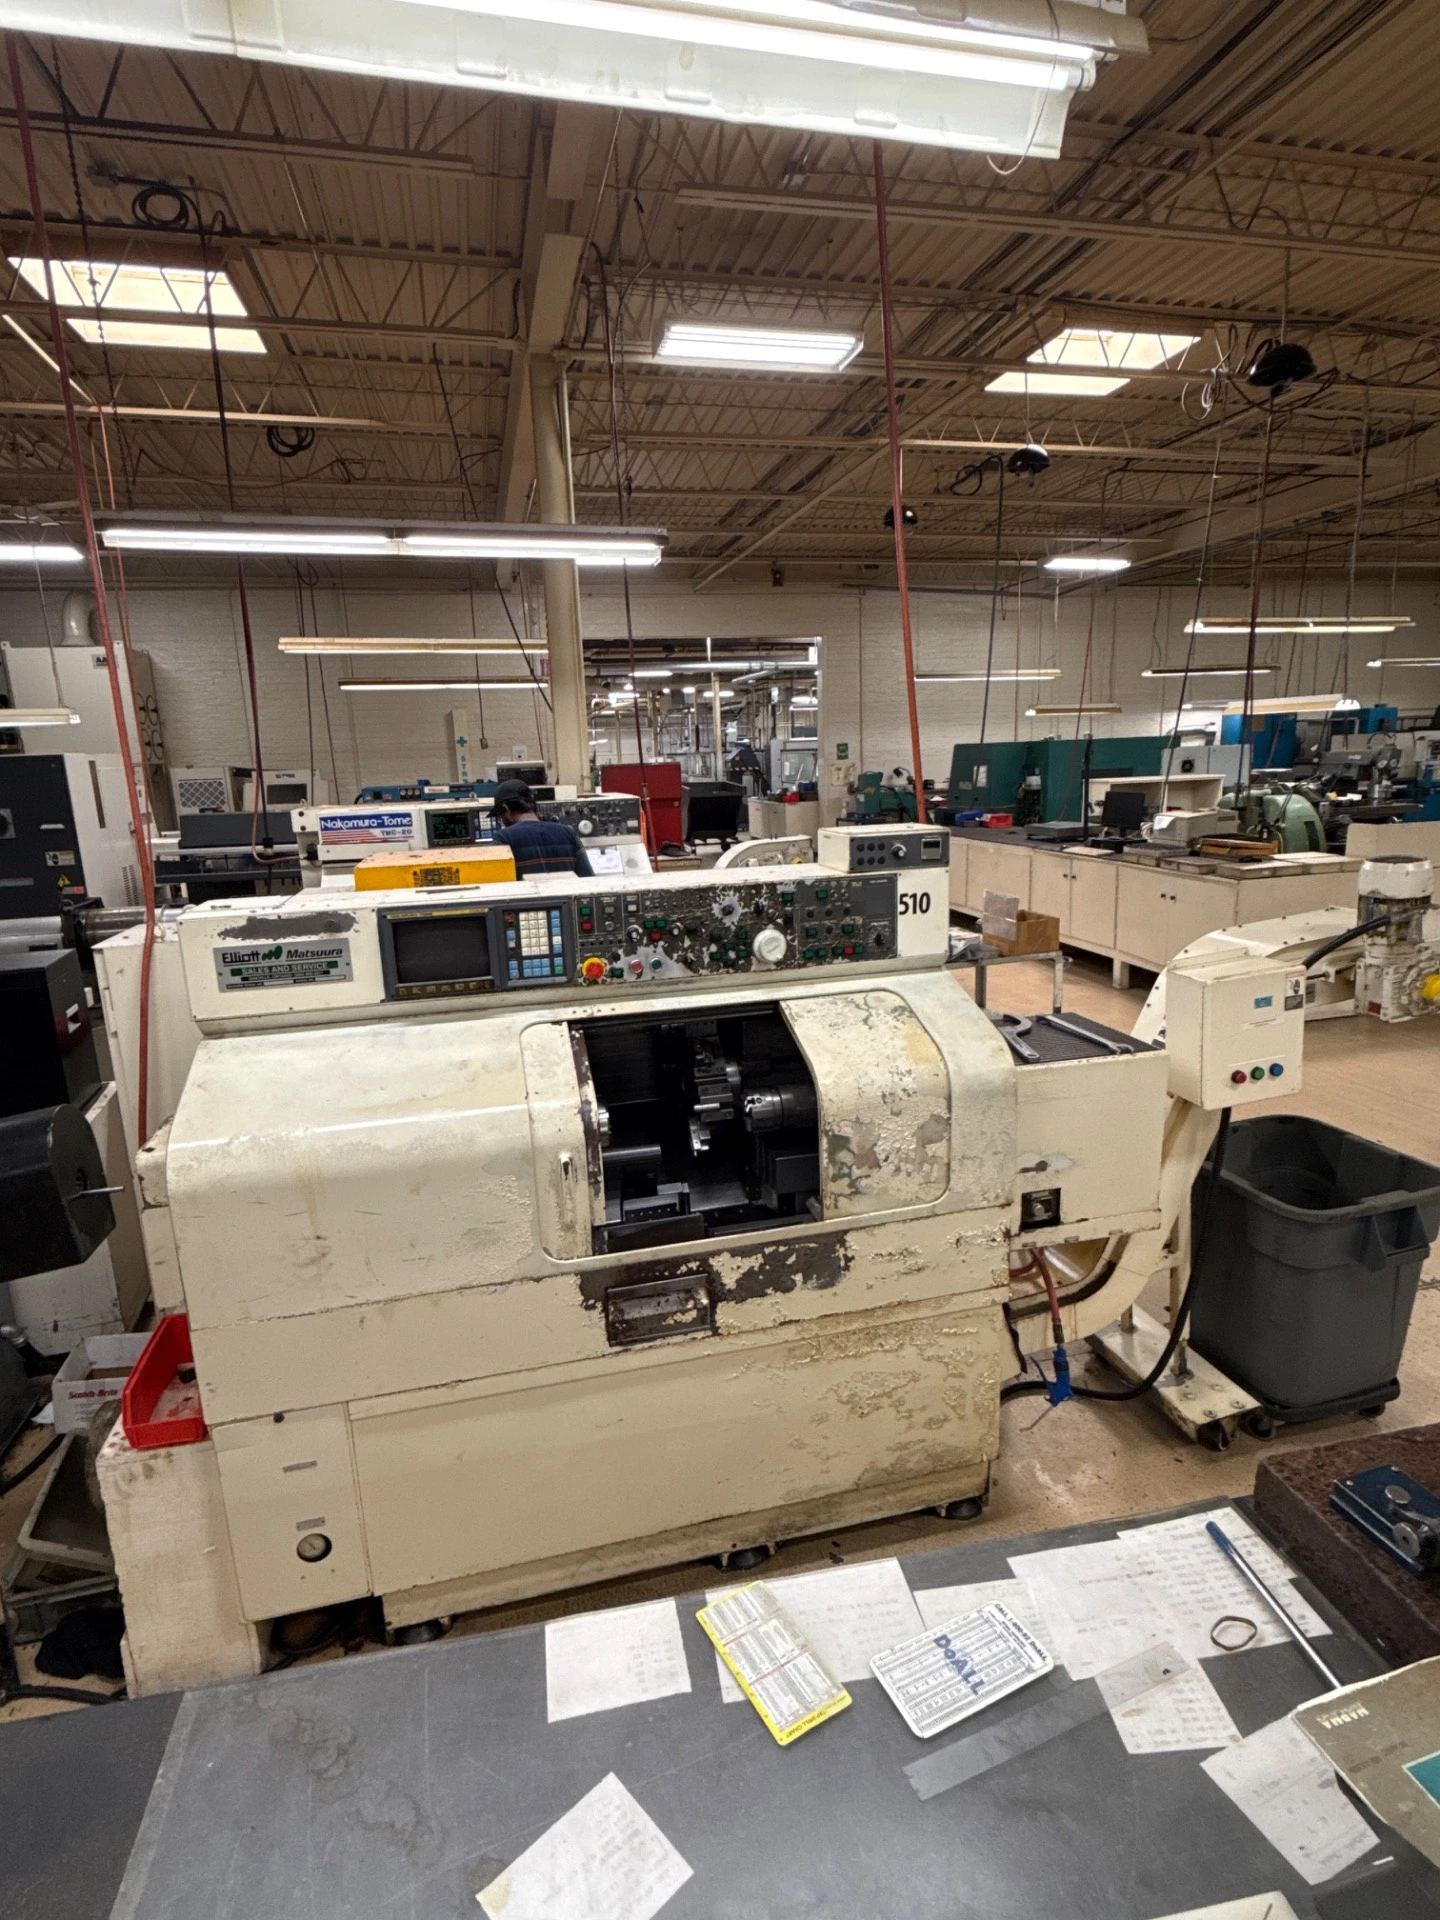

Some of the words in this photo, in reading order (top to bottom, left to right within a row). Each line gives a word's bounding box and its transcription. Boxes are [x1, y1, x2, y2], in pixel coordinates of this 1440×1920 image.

[321, 815, 412, 831] Nakamura-Tome
[380, 828, 412, 837] TMC-20
[898, 891, 931, 915] 510
[222, 950, 261, 964] Elliott
[286, 947, 343, 960] Matsuura
[242, 966, 269, 976] SALES
[271, 965, 290, 974] AND
[291, 962, 328, 972] SERVICE
[68, 1389, 118, 1400] Scotch-Brite
[933, 1633, 986, 1696] DoALL
[786, 1724, 803, 1738] CHART
